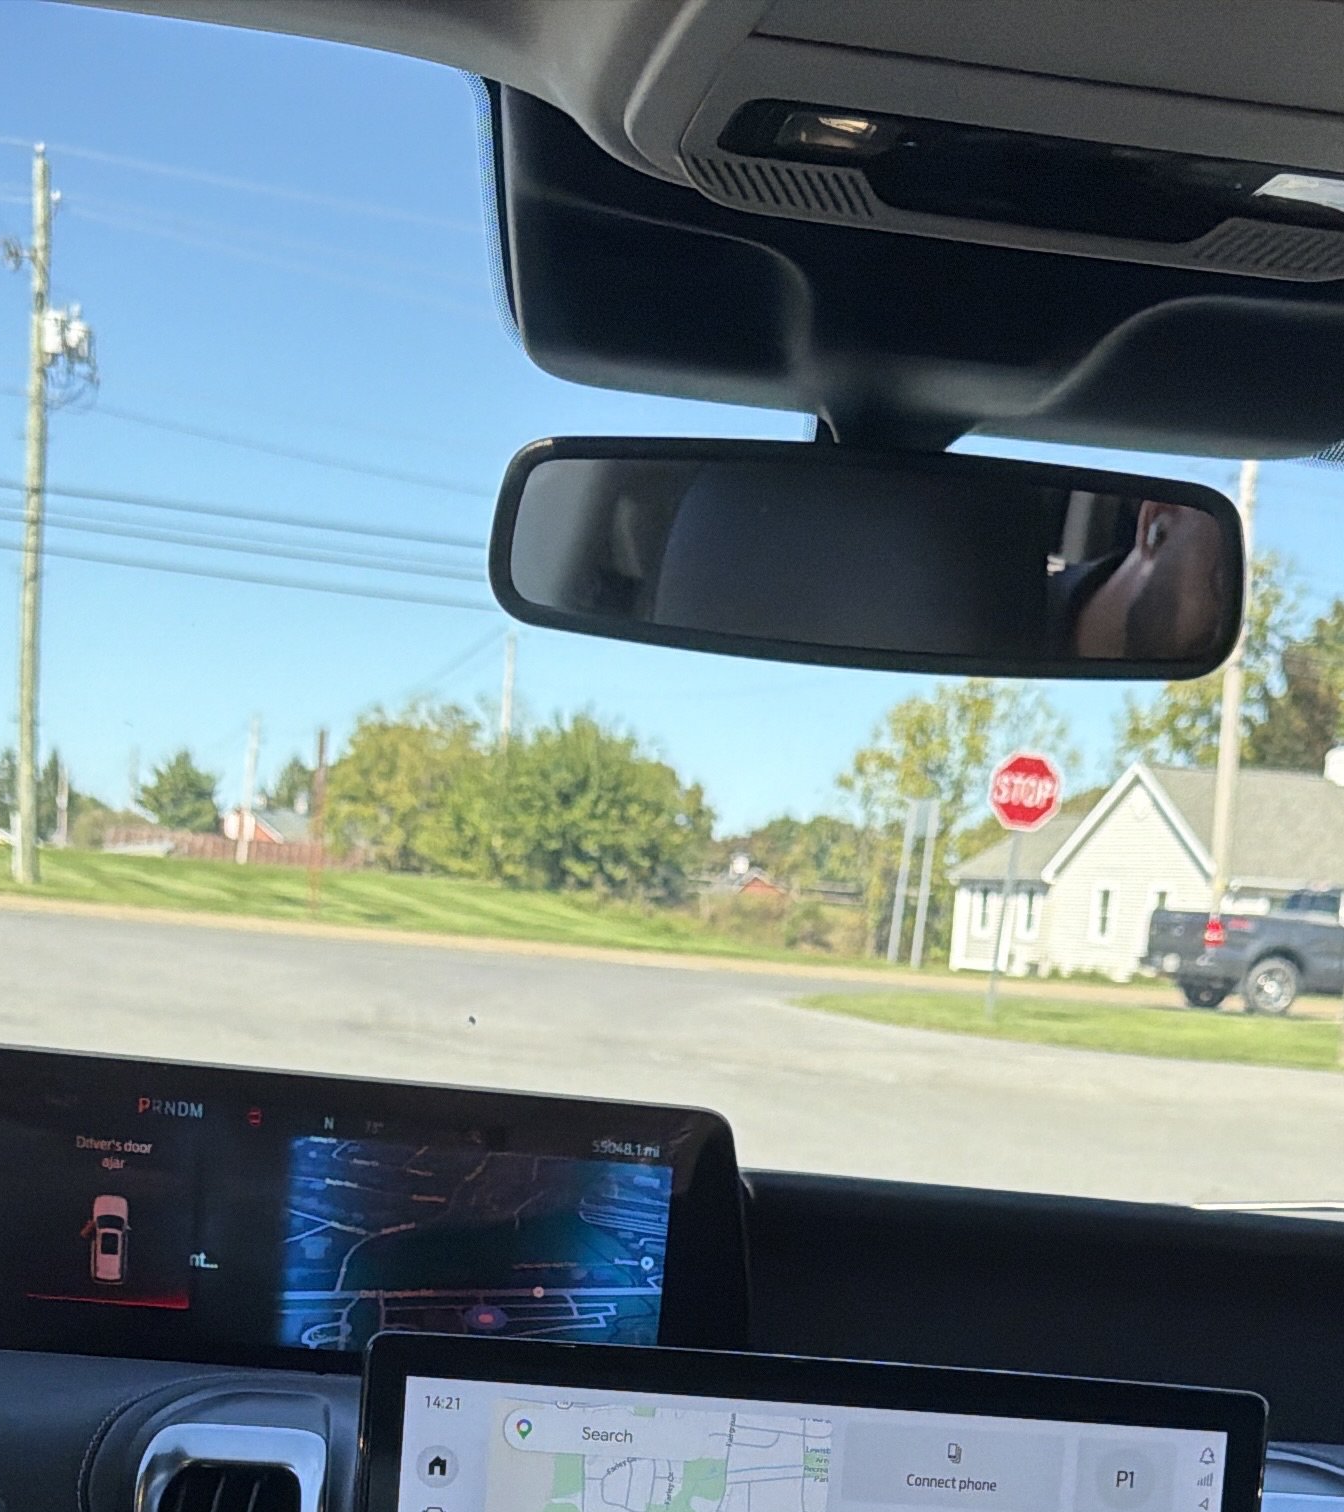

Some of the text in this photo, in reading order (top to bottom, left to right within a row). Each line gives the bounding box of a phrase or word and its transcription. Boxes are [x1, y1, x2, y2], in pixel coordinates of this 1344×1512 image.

[994, 773, 1053, 808] STOP
[76, 1136, 152, 1154] Driver's door
[102, 1156, 125, 1170] ajar
[425, 1395, 461, 1410] 14:21
[582, 1427, 633, 1443] Search
[906, 1473, 997, 1492] Connect phone
